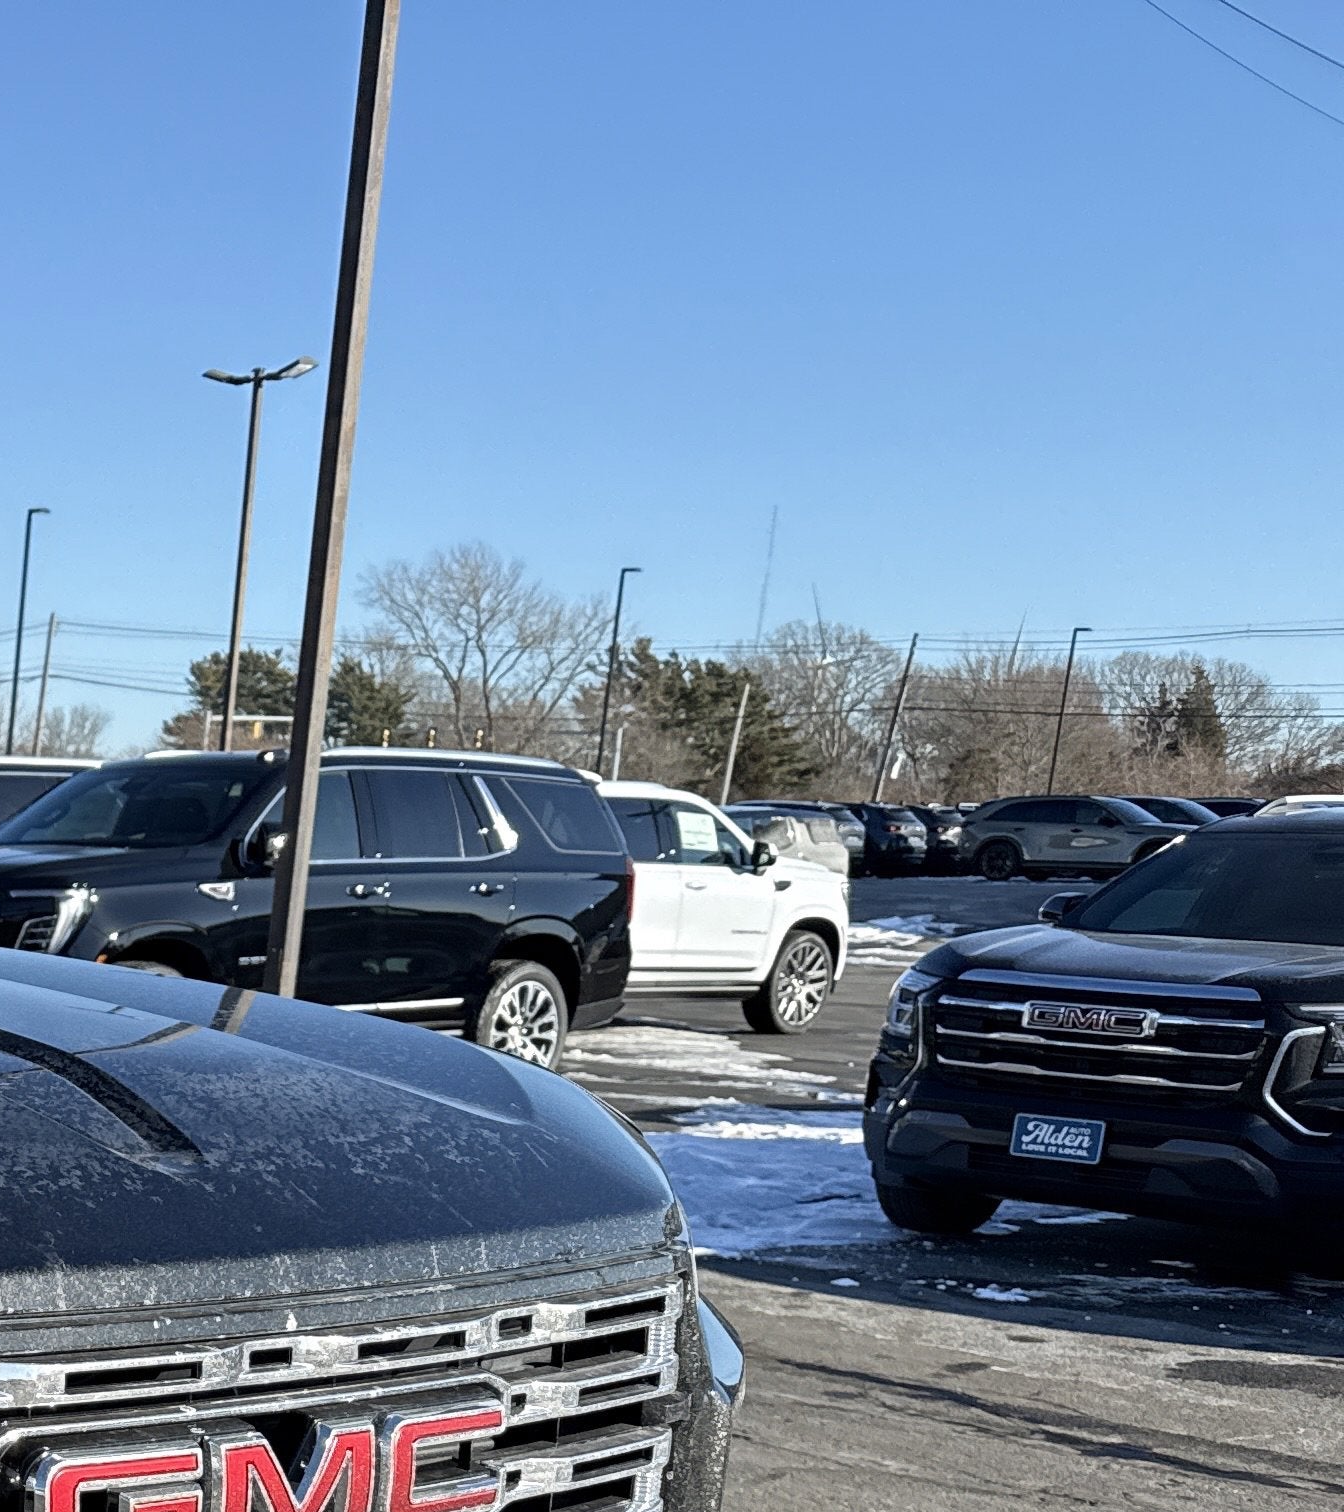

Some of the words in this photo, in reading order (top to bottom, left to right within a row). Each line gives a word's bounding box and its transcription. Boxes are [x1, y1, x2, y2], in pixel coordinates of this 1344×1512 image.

[1028, 1005, 1146, 1034] GMC
[1020, 1121, 1092, 1148] Alden
[1021, 1143, 1046, 1152] LOVE
[1058, 1147, 1089, 1157] LOCAL
